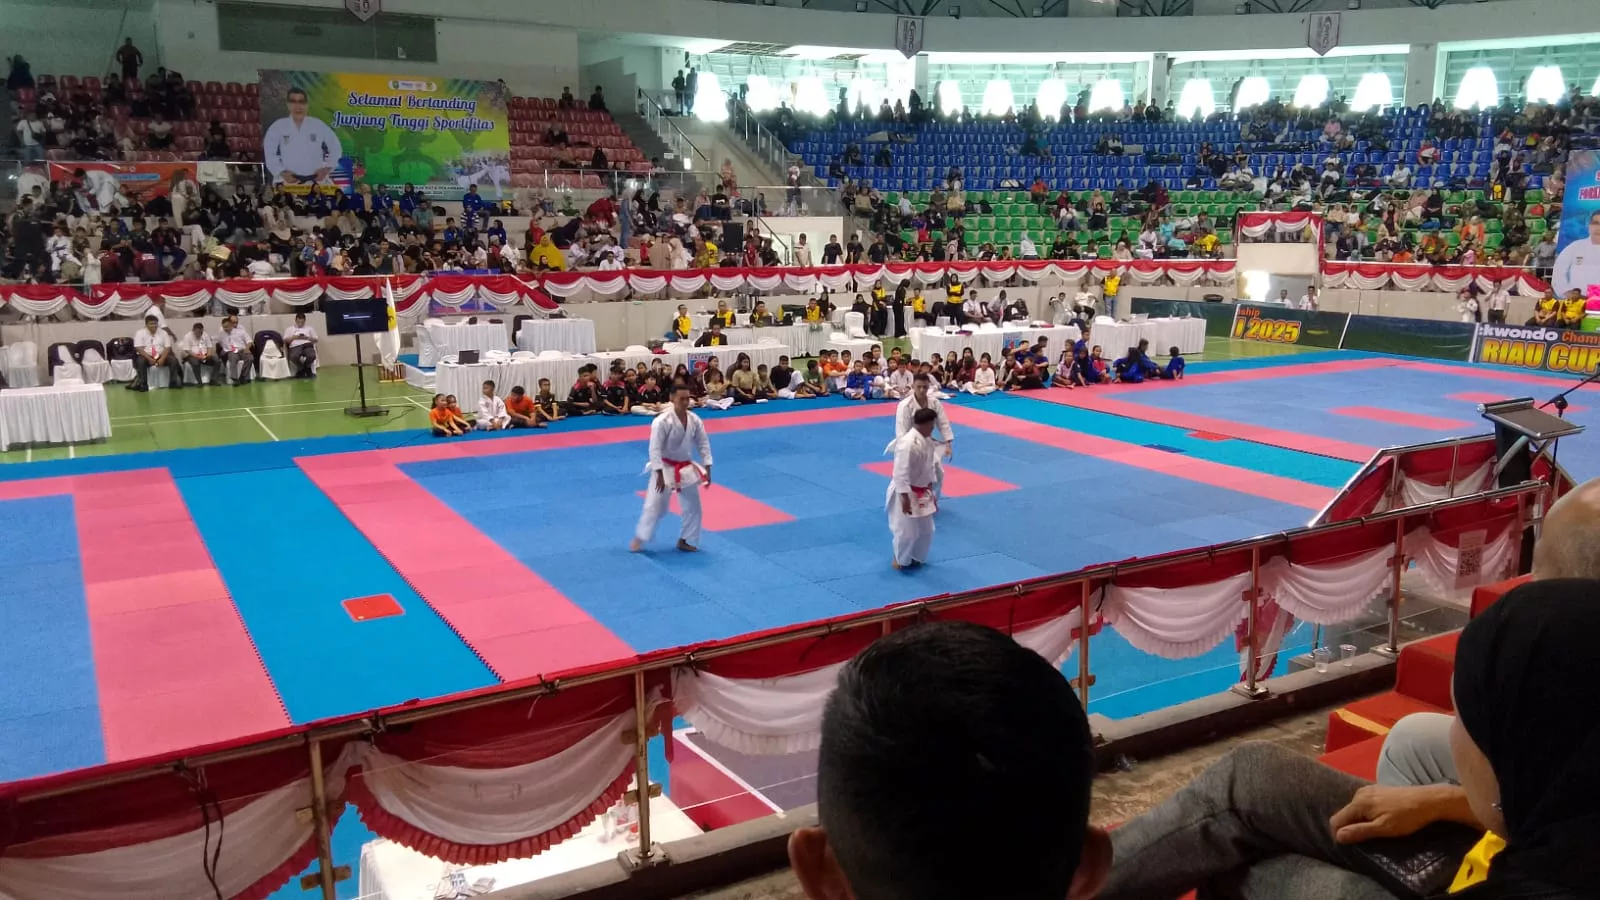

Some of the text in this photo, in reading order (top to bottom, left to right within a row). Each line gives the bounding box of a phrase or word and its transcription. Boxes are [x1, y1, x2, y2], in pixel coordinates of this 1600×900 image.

[349, 91, 476, 113] Selamat Bertanding
[335, 111, 494, 132] Junjung Tinggi Sportifitas
[1245, 318, 1301, 343] 2025
[1483, 338, 1600, 374] RIAU CUP
